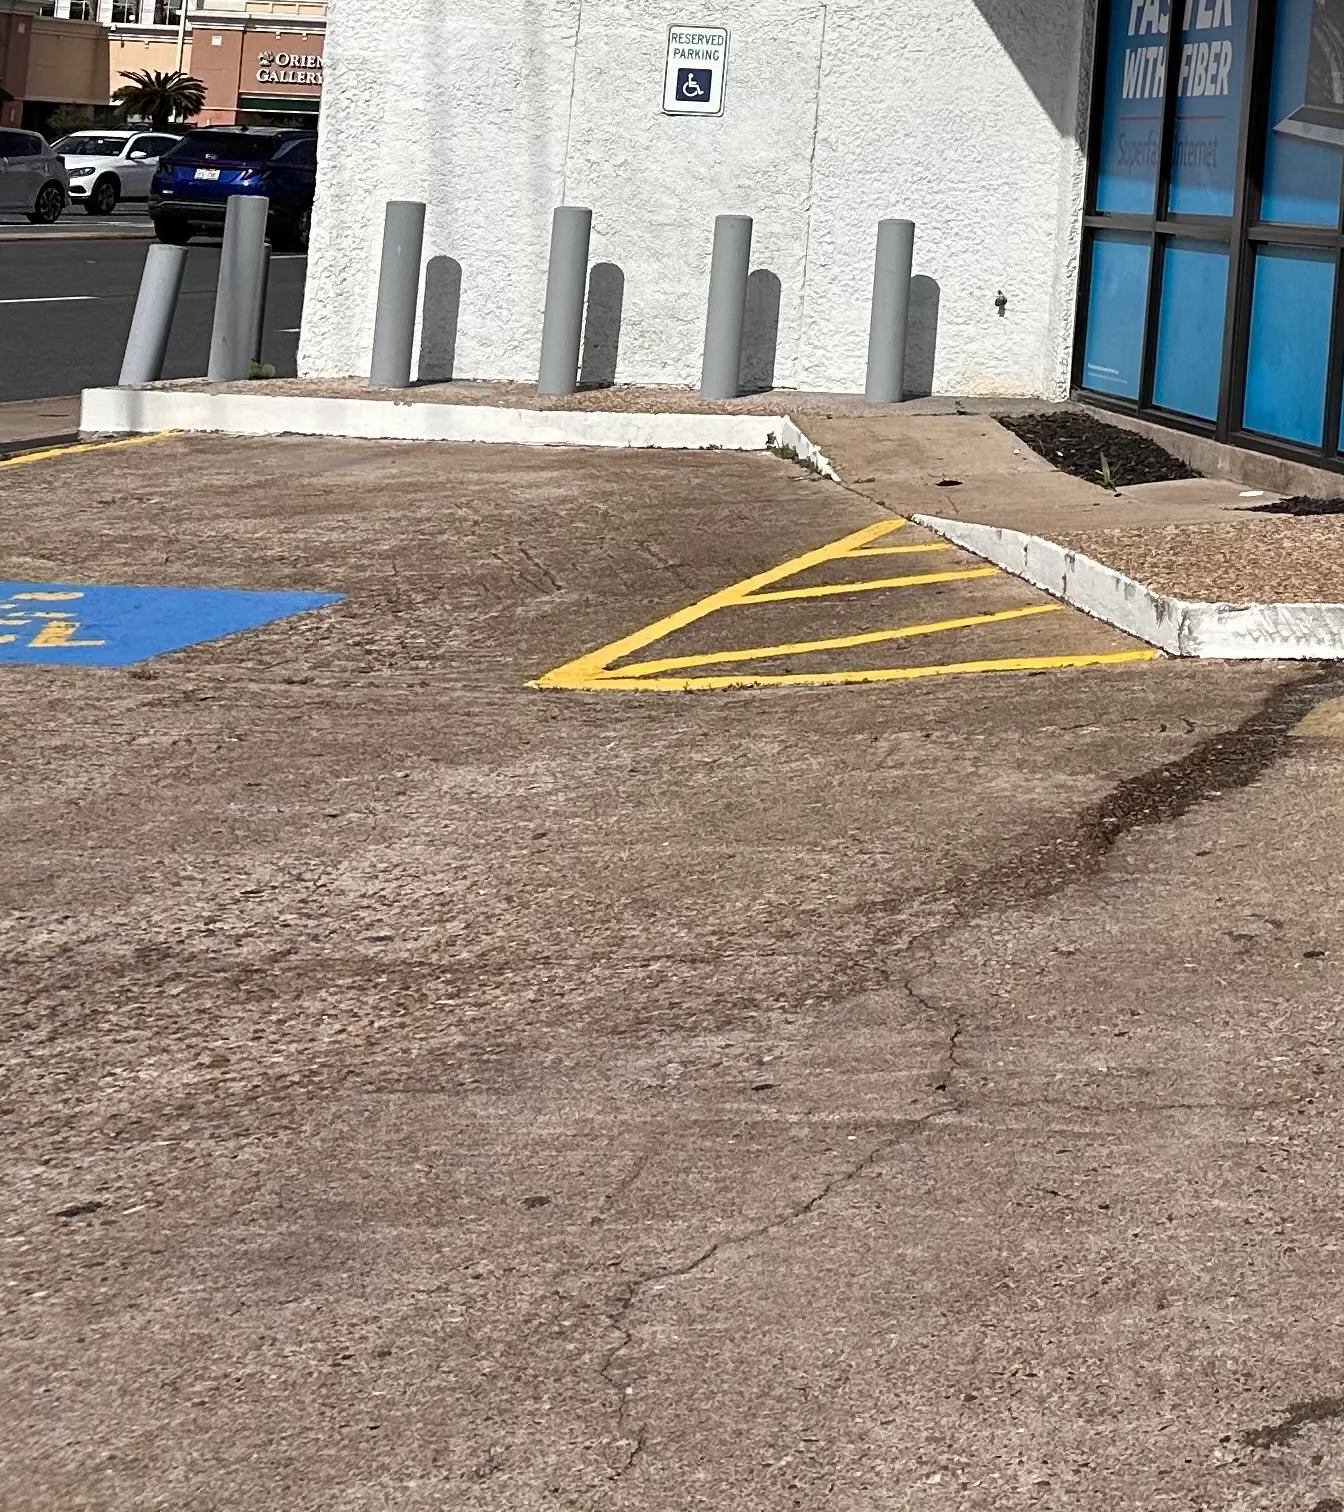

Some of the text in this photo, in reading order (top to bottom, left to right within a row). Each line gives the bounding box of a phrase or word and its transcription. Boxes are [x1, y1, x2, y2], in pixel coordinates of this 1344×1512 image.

[671, 32, 724, 47] RESERVED
[673, 47, 720, 61] PARKING
[1177, 40, 1232, 97] FIBER
[1117, 129, 1159, 176] Superfa
